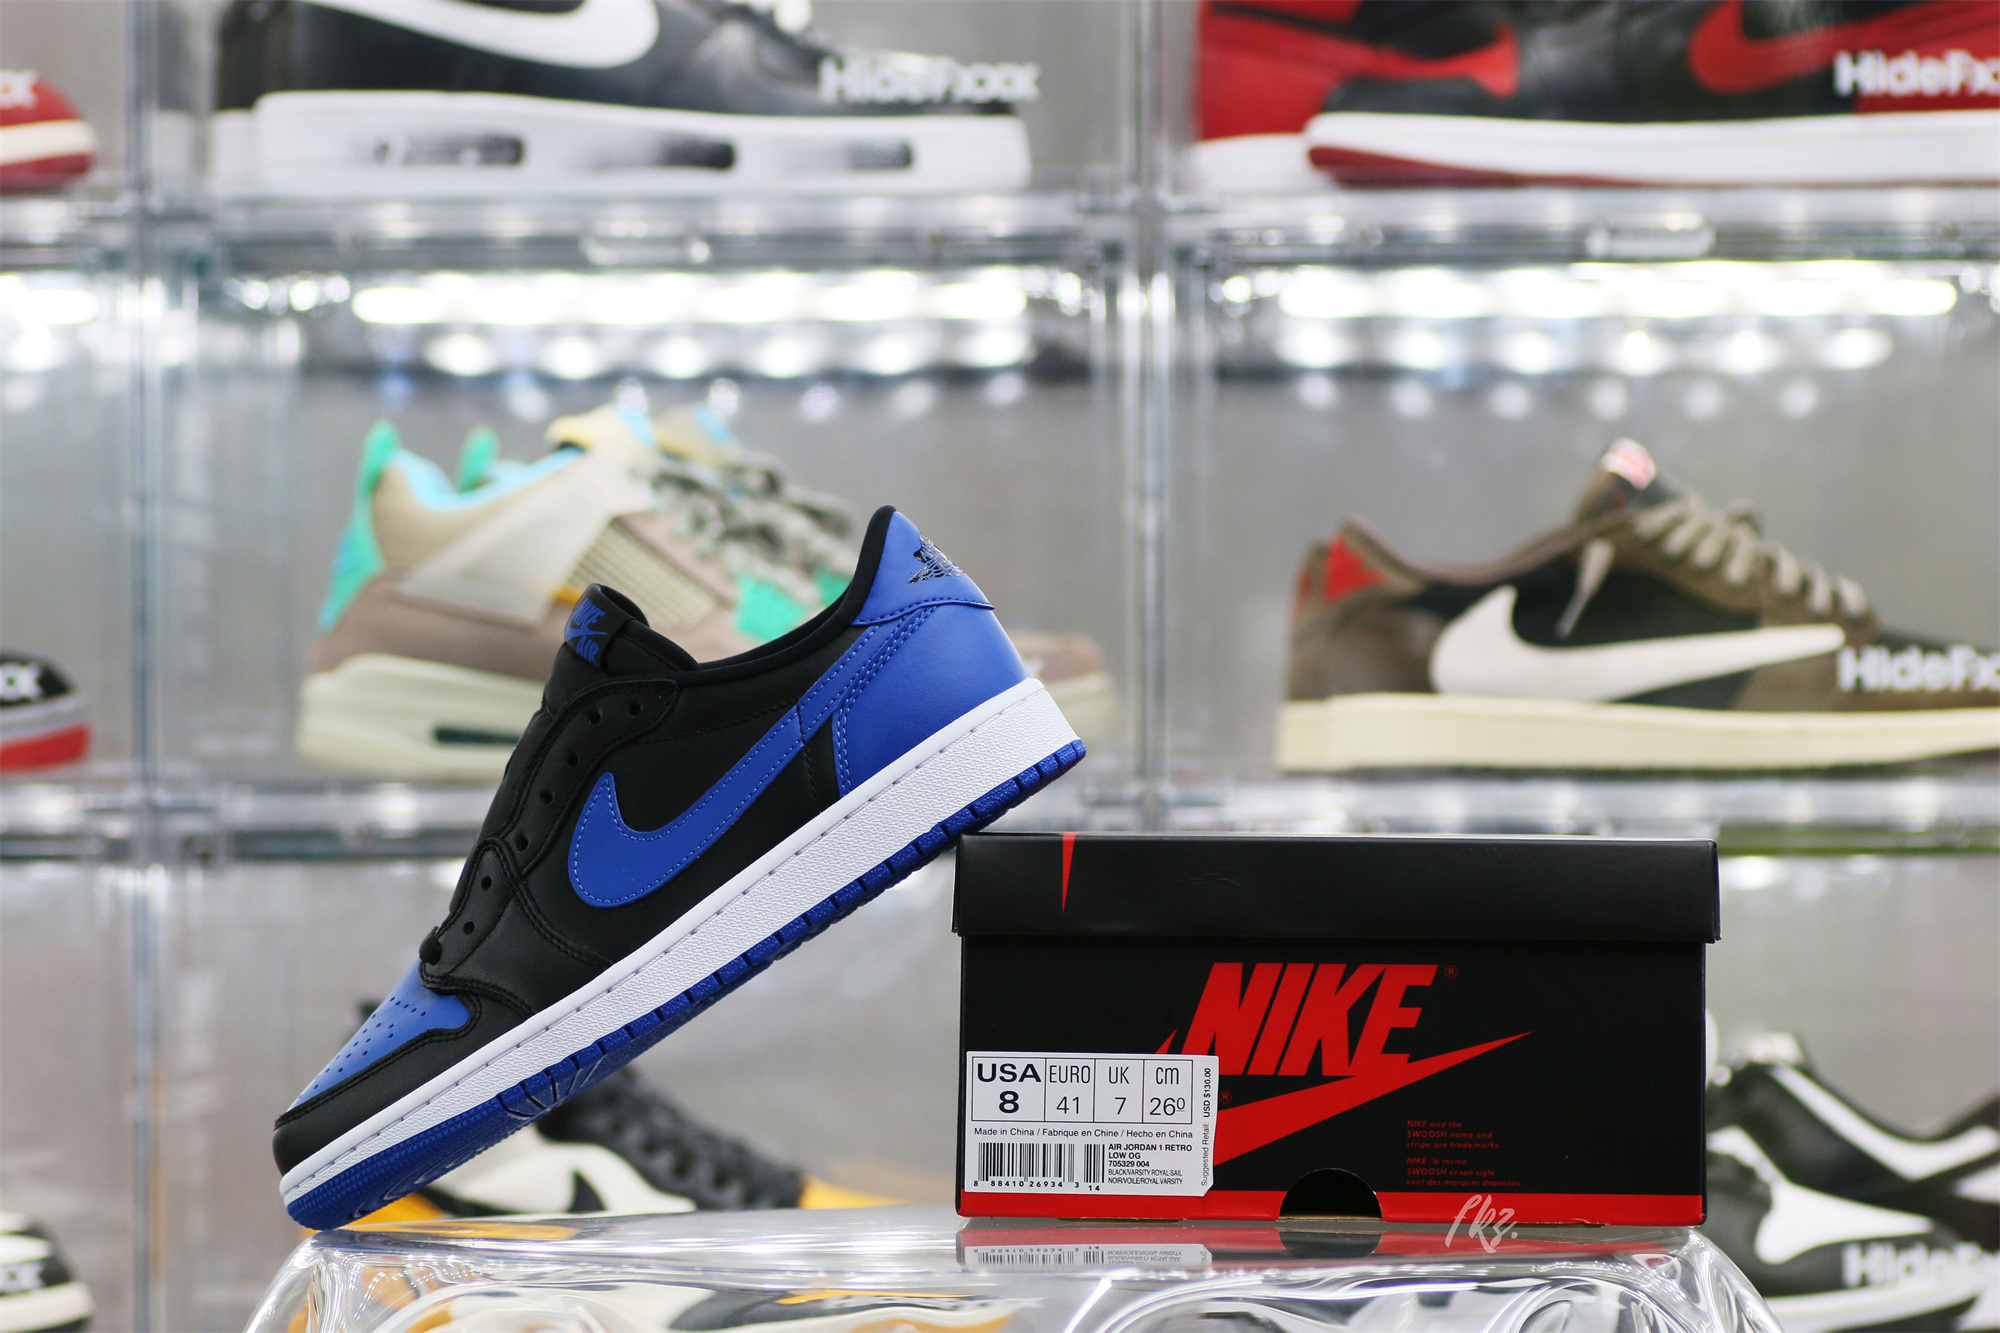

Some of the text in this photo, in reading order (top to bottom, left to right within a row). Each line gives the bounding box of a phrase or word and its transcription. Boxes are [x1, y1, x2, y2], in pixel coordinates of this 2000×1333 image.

[1180, 962, 1439, 1077] NIKE
[977, 1063, 1042, 1083] USA
[1049, 1065, 1091, 1084] EURO
[1108, 1066, 1130, 1084] UK
[998, 1090, 1020, 1114] 8
[1056, 1096, 1080, 1115] 41
[1114, 1097, 1127, 1115] 7
[1201, 1067, 1212, 1186] Suggested Retail: USD $130.00
[1406, 1120, 1427, 1128] NIKE
[974, 1128, 998, 1136] Made
[1000, 1128, 1008, 1136] in
[1010, 1128, 1035, 1136] China
[1042, 1129, 1079, 1138] Fabrique
[1094, 1129, 1119, 1137] Chine
[1126, 1130, 1154, 1138] Hecho
[1169, 1130, 1193, 1138] China
[1406, 1130, 1448, 1138] SWOOSH
[1165, 1144, 1193, 1152] RETRO
[1128, 1152, 1141, 1160] OG
[1108, 1160, 1150, 1168] 705329 004
[1406, 1168, 1447, 1176] SWOOSH
